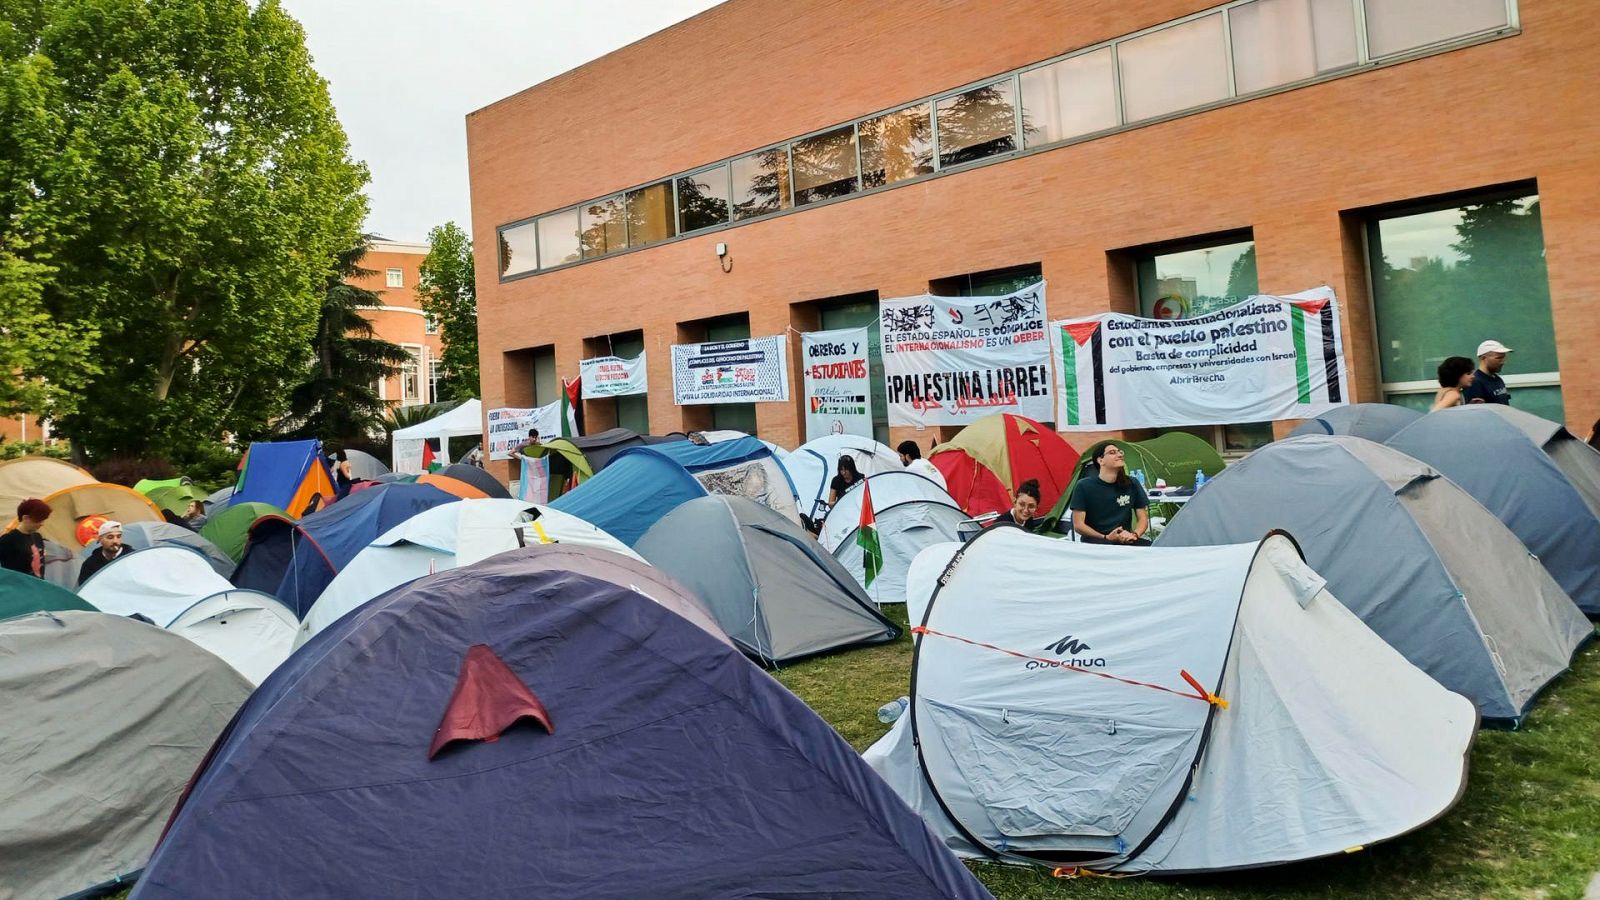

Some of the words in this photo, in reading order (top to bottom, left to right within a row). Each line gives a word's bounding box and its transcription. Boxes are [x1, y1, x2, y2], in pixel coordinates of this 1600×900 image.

[1207, 295, 1238, 306] Casa
[885, 334, 894, 343] EL
[896, 331, 930, 342] ESTADO
[932, 327, 976, 341] ESPAÑOL
[978, 327, 990, 337] ES
[885, 344, 894, 353] EL
[896, 338, 984, 353] INTERNACIONALISMO
[986, 337, 997, 347] ES
[999, 336, 1011, 346] UN
[1013, 331, 1045, 344] DEBER
[1109, 336, 1134, 348] con
[1138, 332, 1151, 346] el
[1154, 329, 1206, 349] pueblo
[1210, 317, 1288, 344] palestino
[808, 342, 846, 358] OBREROS
[852, 341, 860, 355] Y
[1136, 350, 1166, 361] Basta
[1168, 348, 1182, 360] de
[1185, 339, 1257, 359] complicidad
[812, 358, 867, 379] ESTUDIANTES
[1109, 365, 1120, 373] del
[1155, 363, 1191, 371] empresas
[1199, 356, 1254, 368] universidades
[1272, 350, 1297, 360] Israel
[887, 370, 984, 404] ¡PALESTINA
[987, 364, 1048, 400] LIBRE!
